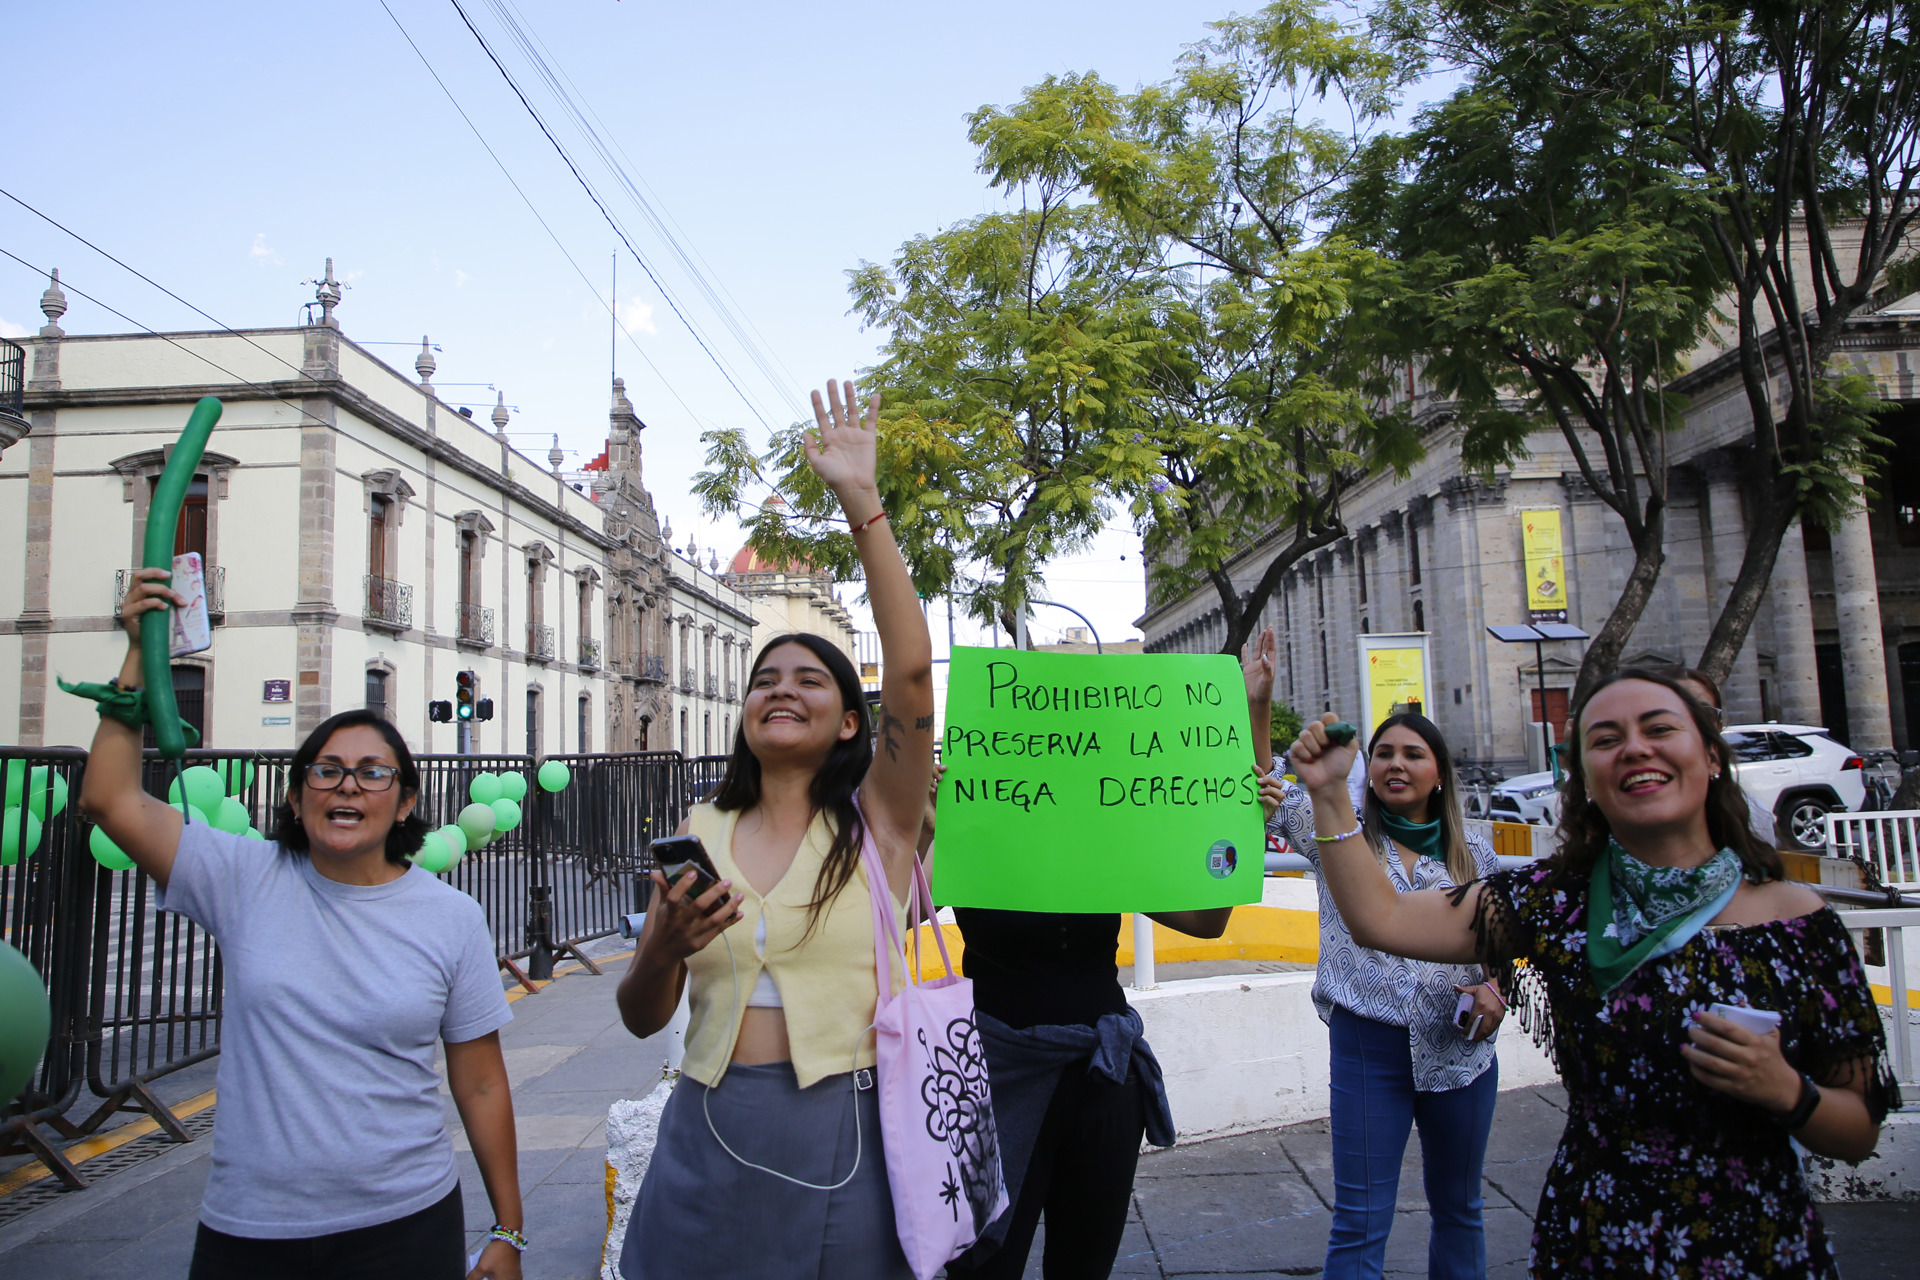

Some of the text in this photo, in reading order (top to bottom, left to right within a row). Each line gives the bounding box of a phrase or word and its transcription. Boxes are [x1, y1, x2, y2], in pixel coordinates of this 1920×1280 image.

[987, 662, 1221, 711] PROHIBIRLO NO
[948, 726, 1238, 757] PRESERVA LA VIDA
[955, 774, 1252, 812] NIEGA DERECHOS
